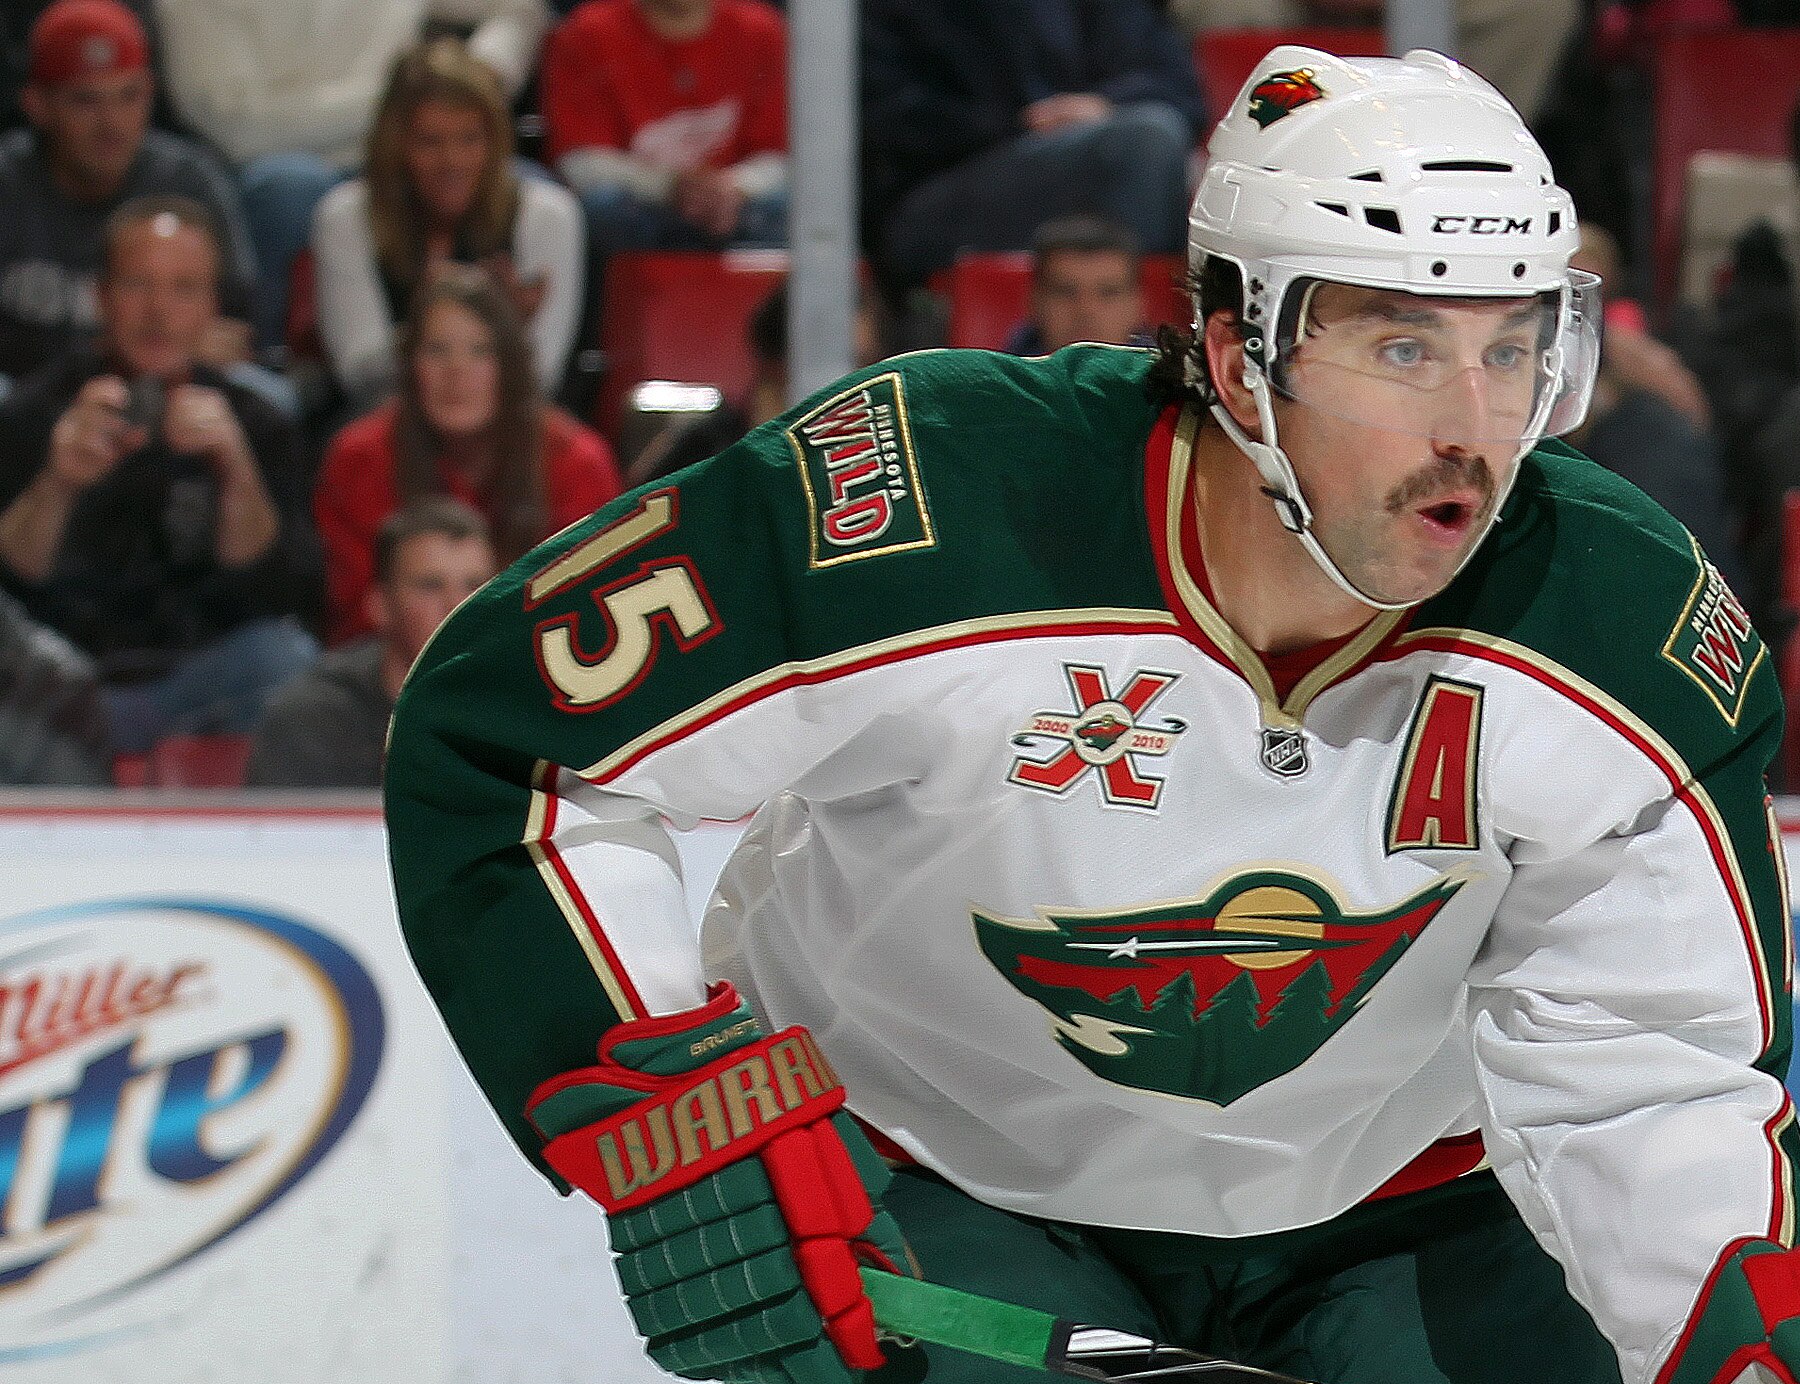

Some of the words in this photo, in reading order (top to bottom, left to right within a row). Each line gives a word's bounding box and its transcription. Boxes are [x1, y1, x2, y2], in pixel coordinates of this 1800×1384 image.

[1431, 215, 1533, 234] CCM
[802, 389, 894, 546] WILD
[523, 486, 725, 714] 15
[1691, 591, 1752, 695] WI
[1032, 717, 1071, 735] 2000
[1130, 733, 1166, 750] 2010
[1382, 672, 1486, 856] A
